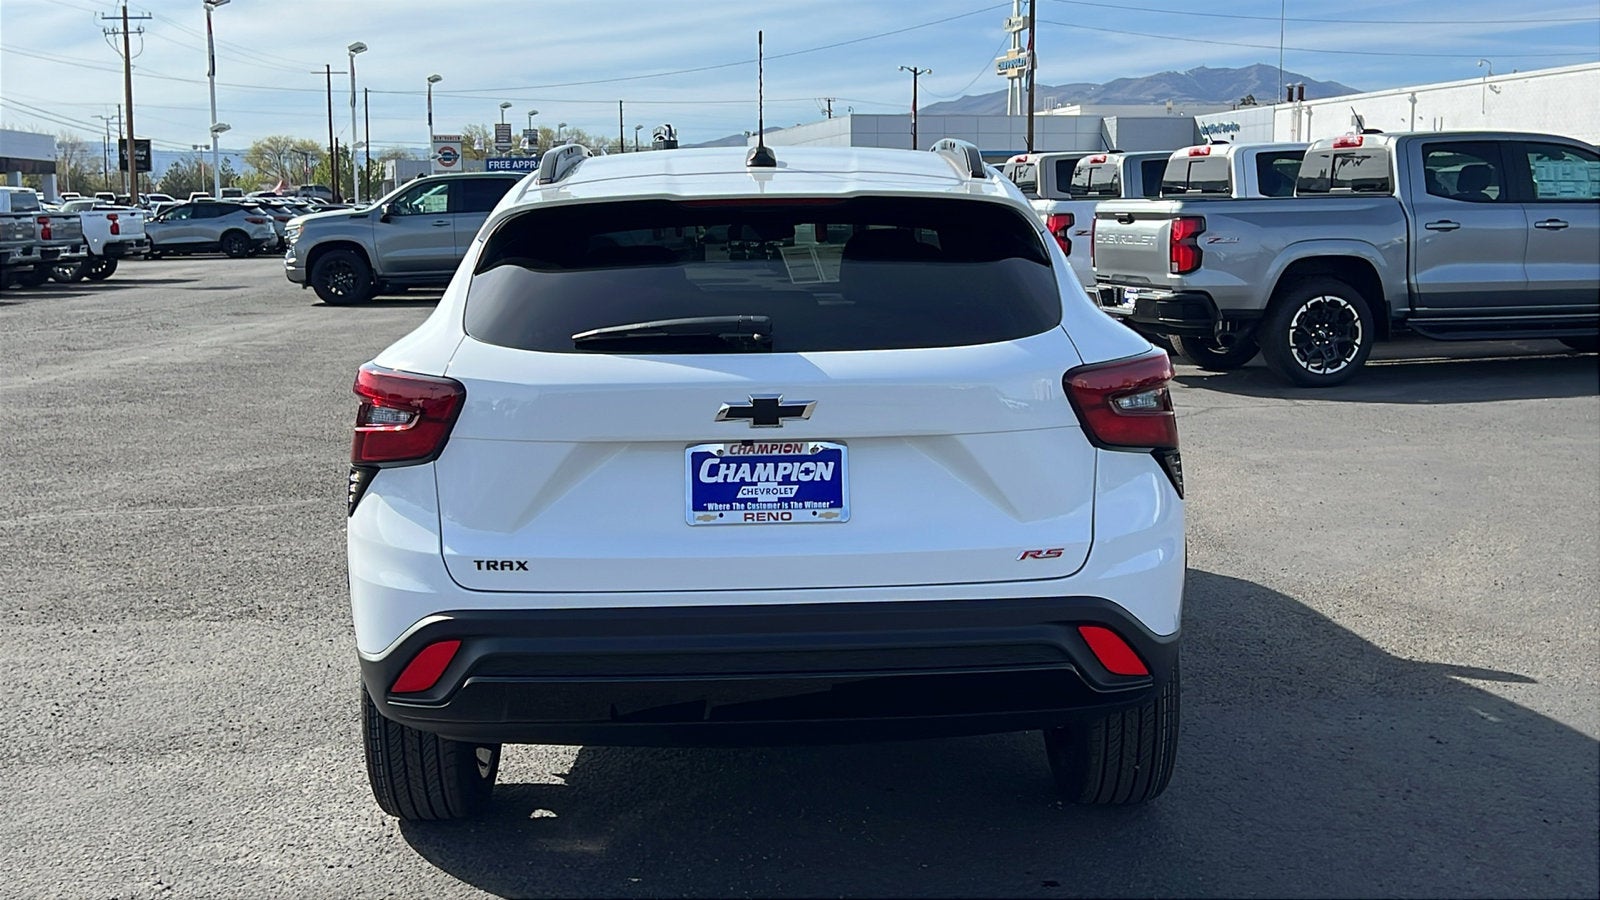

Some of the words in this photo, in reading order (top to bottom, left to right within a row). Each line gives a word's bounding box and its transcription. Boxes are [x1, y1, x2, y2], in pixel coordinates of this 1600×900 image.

[488, 160, 511, 169] FREE
[729, 442, 804, 456] CHAMPION
[699, 458, 834, 483] CHAMPION
[741, 487, 794, 496] CHEVROLET
[732, 502, 744, 510] The
[746, 501, 781, 510] Customer
[790, 501, 803, 509] The
[743, 511, 793, 522] RENO
[1015, 547, 1065, 561] RS
[473, 560, 529, 571] TRAX
